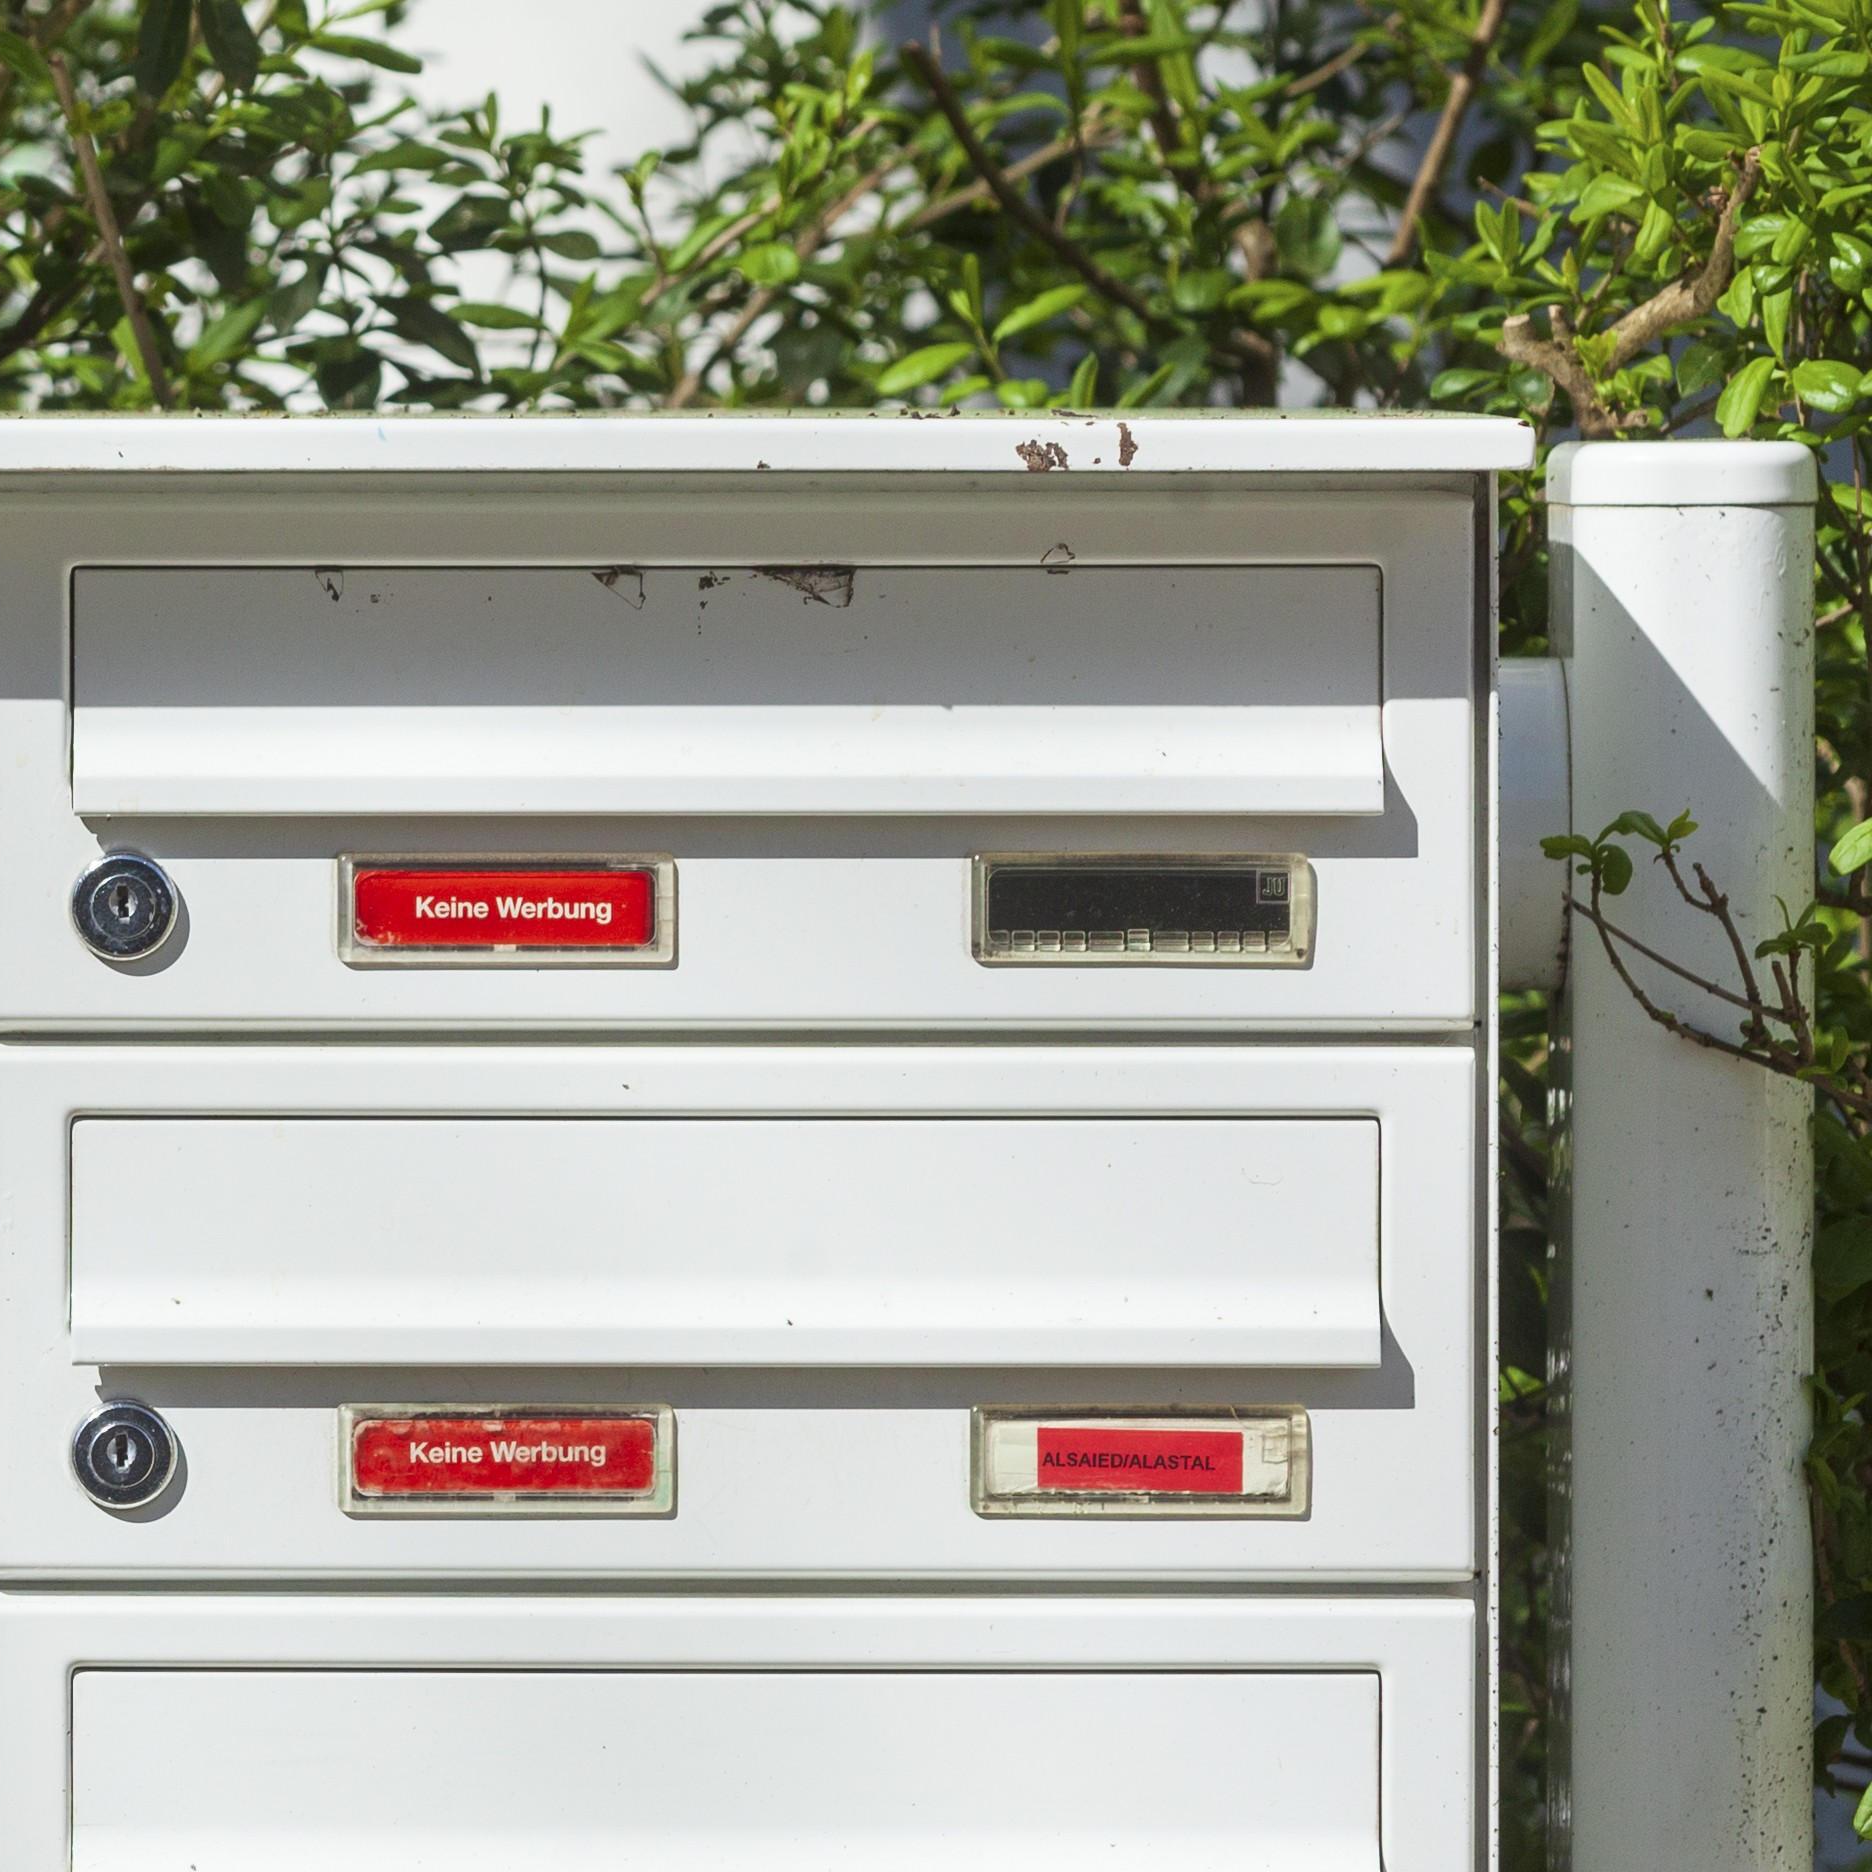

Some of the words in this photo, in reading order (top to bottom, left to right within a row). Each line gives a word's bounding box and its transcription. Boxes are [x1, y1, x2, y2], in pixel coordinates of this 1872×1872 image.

[417, 897, 488, 918] Keine
[496, 897, 612, 924] Werbung
[410, 1442, 482, 1463] Keine
[490, 1442, 606, 1467] Werbung
[1042, 1452, 1215, 1471] ALSAIED/ALASTAL
